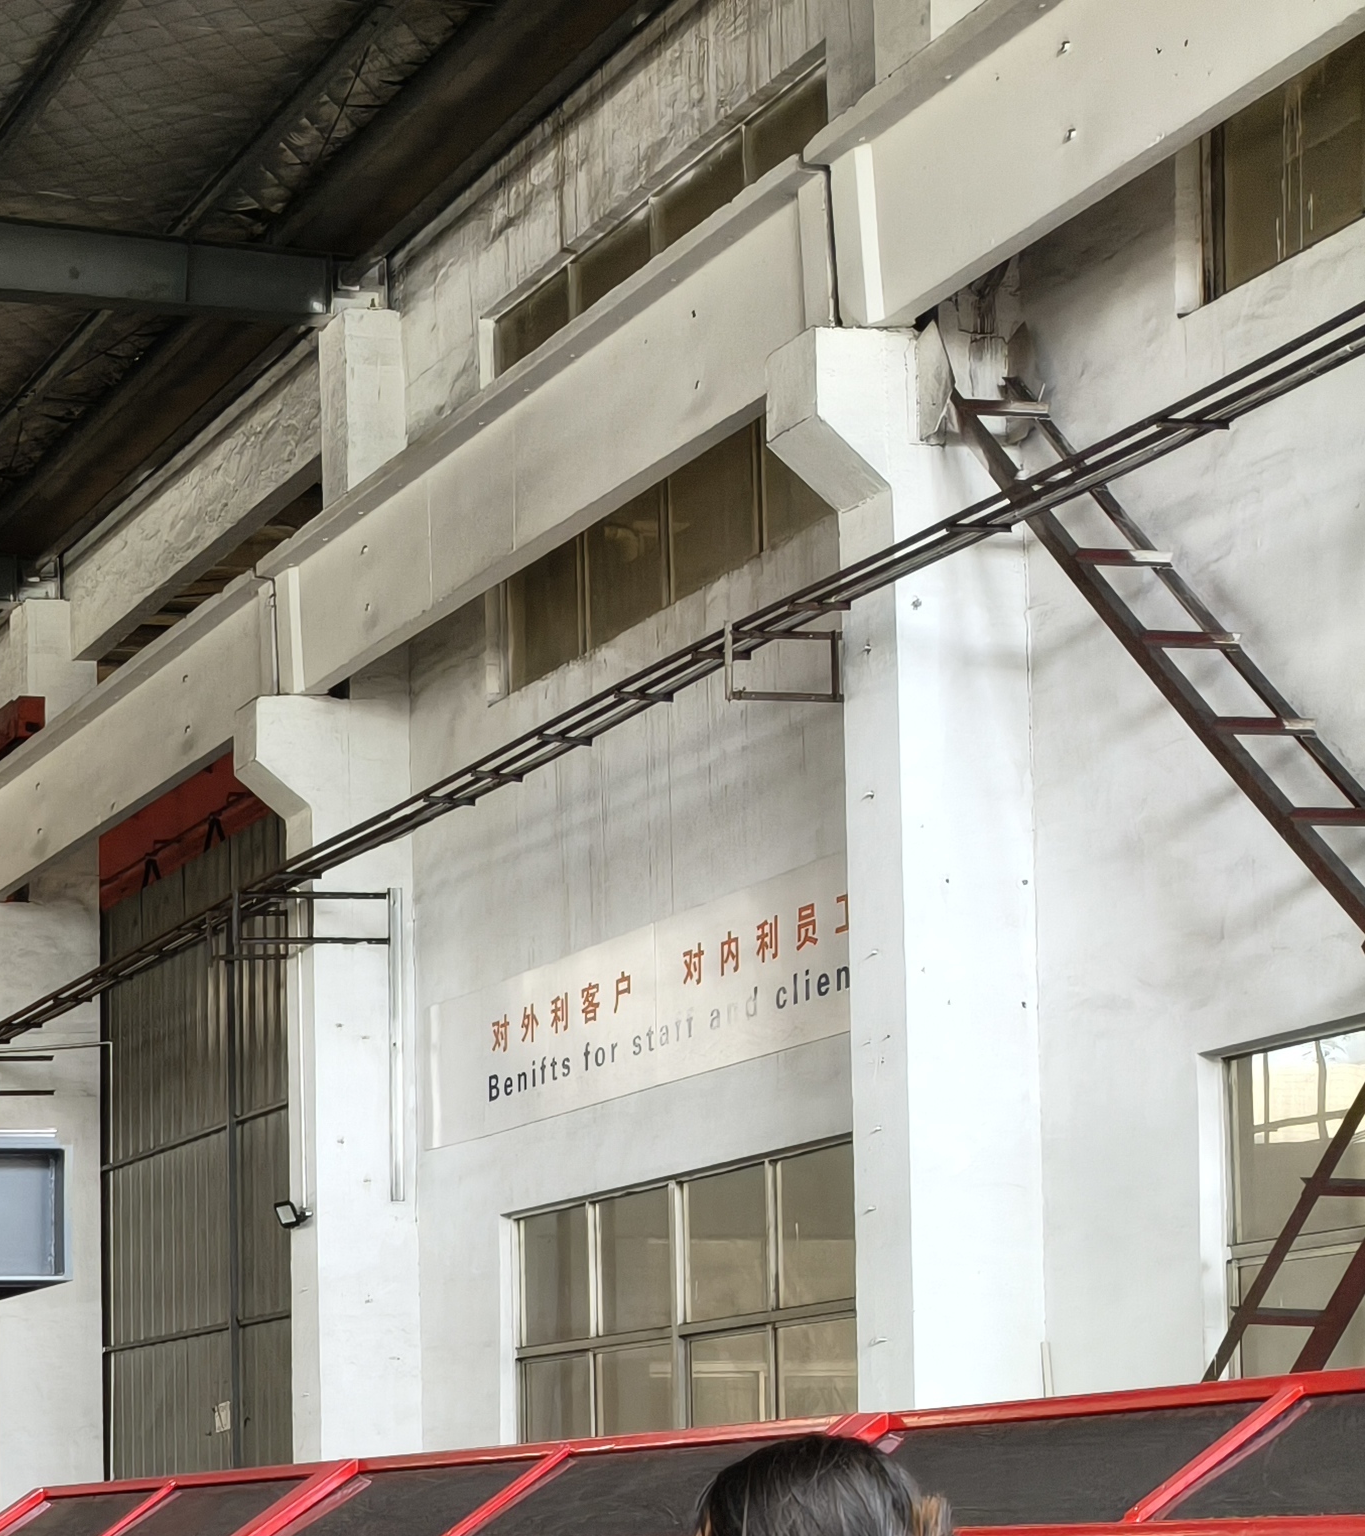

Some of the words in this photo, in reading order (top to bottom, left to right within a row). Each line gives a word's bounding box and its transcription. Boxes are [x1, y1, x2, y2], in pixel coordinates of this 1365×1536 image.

[491, 970, 632, 1053] 对外利客户
[488, 1054, 571, 1102] Benifts
[582, 1040, 618, 1071] for
